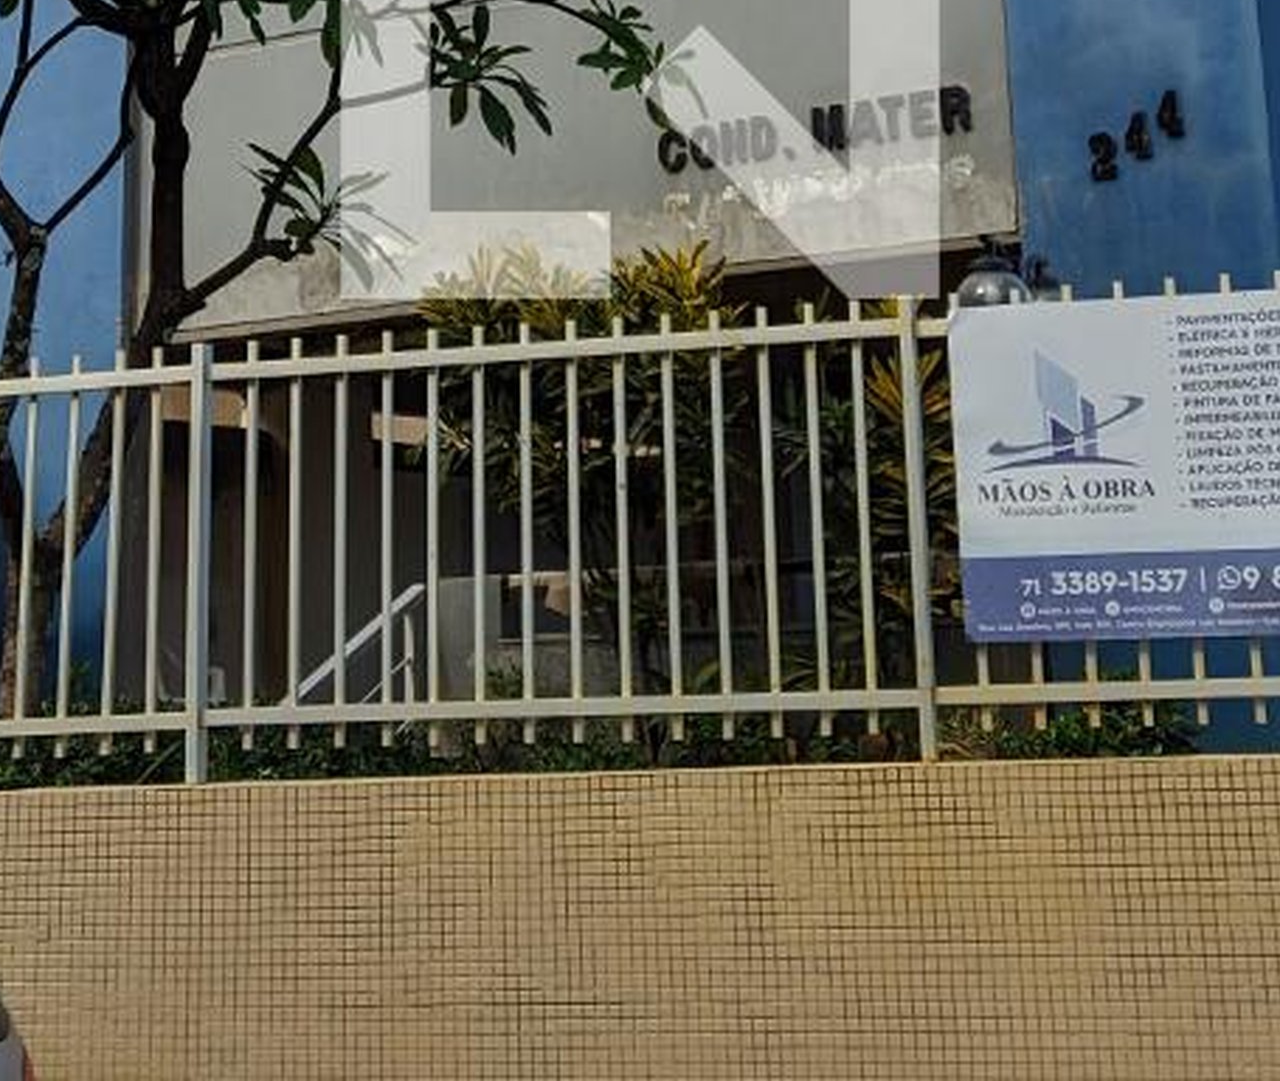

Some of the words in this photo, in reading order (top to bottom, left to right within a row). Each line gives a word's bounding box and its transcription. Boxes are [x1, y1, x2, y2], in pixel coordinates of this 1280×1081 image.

[657, 114, 796, 174] COND.
[811, 84, 973, 152] MATER
[1088, 89, 1187, 183] 244
[1254, 343, 1270, 356] DE
[1243, 394, 1261, 406] DE
[1247, 427, 1264, 439] DE
[978, 477, 1051, 504] MÃOS
[1058, 475, 1076, 501] À
[1083, 477, 1155, 499] OBRA
[1021, 578, 1041, 597] 71
[1050, 566, 1188, 597] 3389-1537
[1242, 566, 1261, 589] 9
